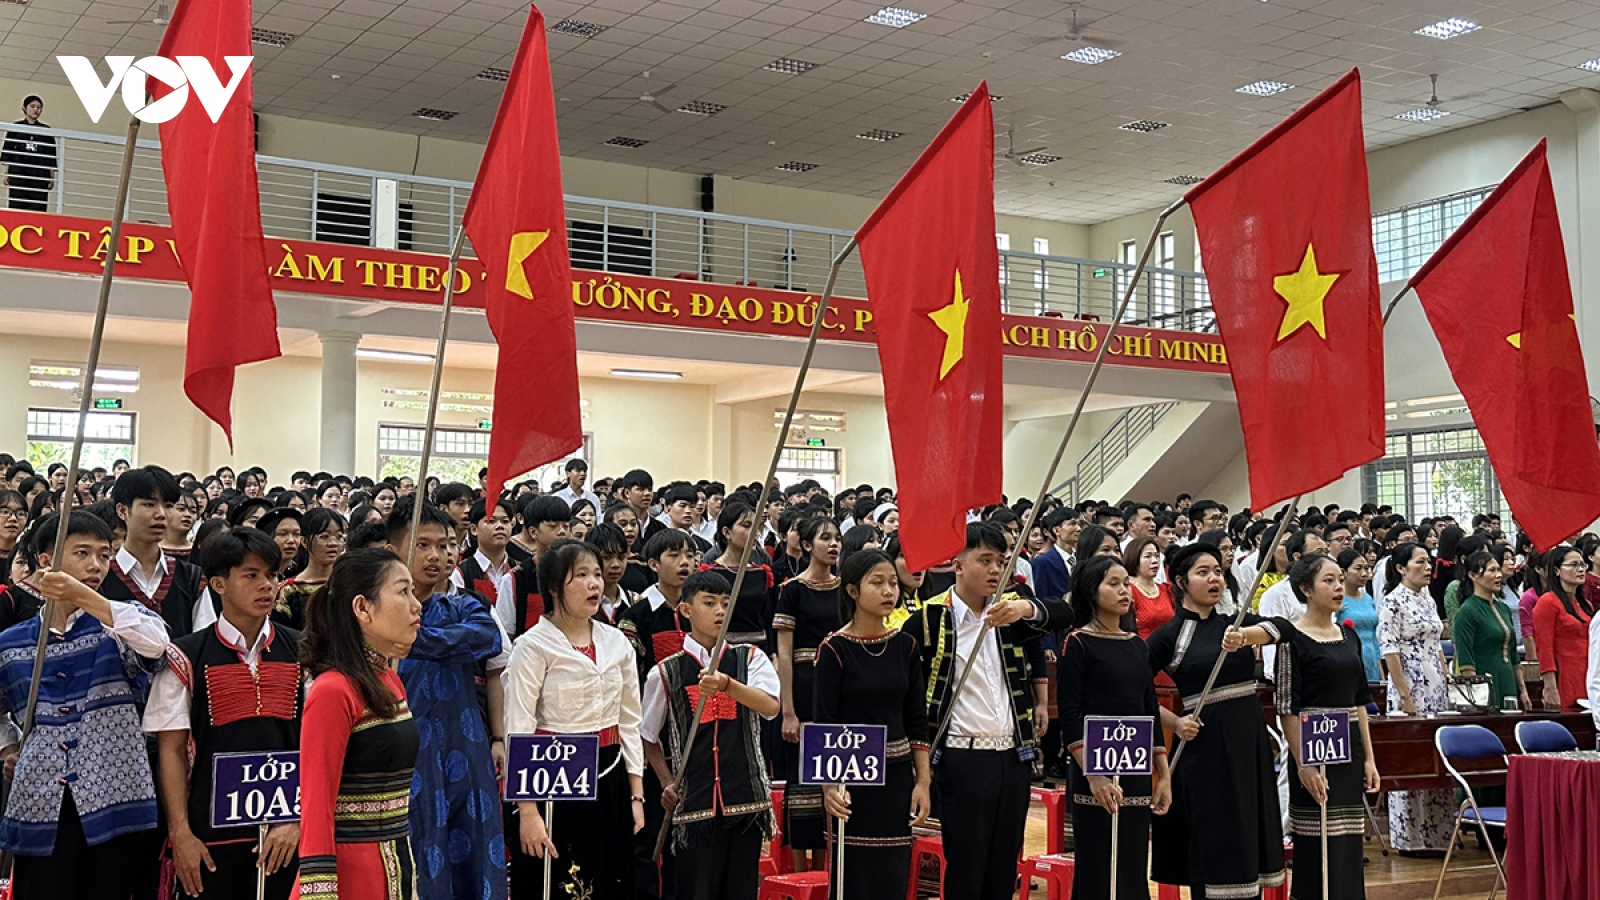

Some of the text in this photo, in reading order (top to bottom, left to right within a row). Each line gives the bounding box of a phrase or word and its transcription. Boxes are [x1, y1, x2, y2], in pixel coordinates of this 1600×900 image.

[58, 226, 155, 267] TẬP
[269, 243, 344, 284] ÀM
[356, 259, 471, 294] THEO
[571, 276, 680, 318] ƯỞNG,
[690, 292, 764, 325] ĐẠO
[771, 295, 846, 333] ĐỨC,
[1001, 316, 1051, 349] CH
[1057, 324, 1098, 353] HỒ
[1107, 331, 1152, 357] CHÍ
[1158, 338, 1228, 365] MINH
[1102, 722, 1137, 741] LỚP
[1312, 715, 1338, 735] LỚP
[530, 739, 577, 761] LỚP
[823, 728, 867, 749] LỚP
[1306, 736, 1346, 762] 10A1
[240, 757, 297, 783] LỚP
[811, 754, 879, 781] 10A3
[1092, 746, 1147, 771] 10A2
[516, 766, 590, 796] 10A4
